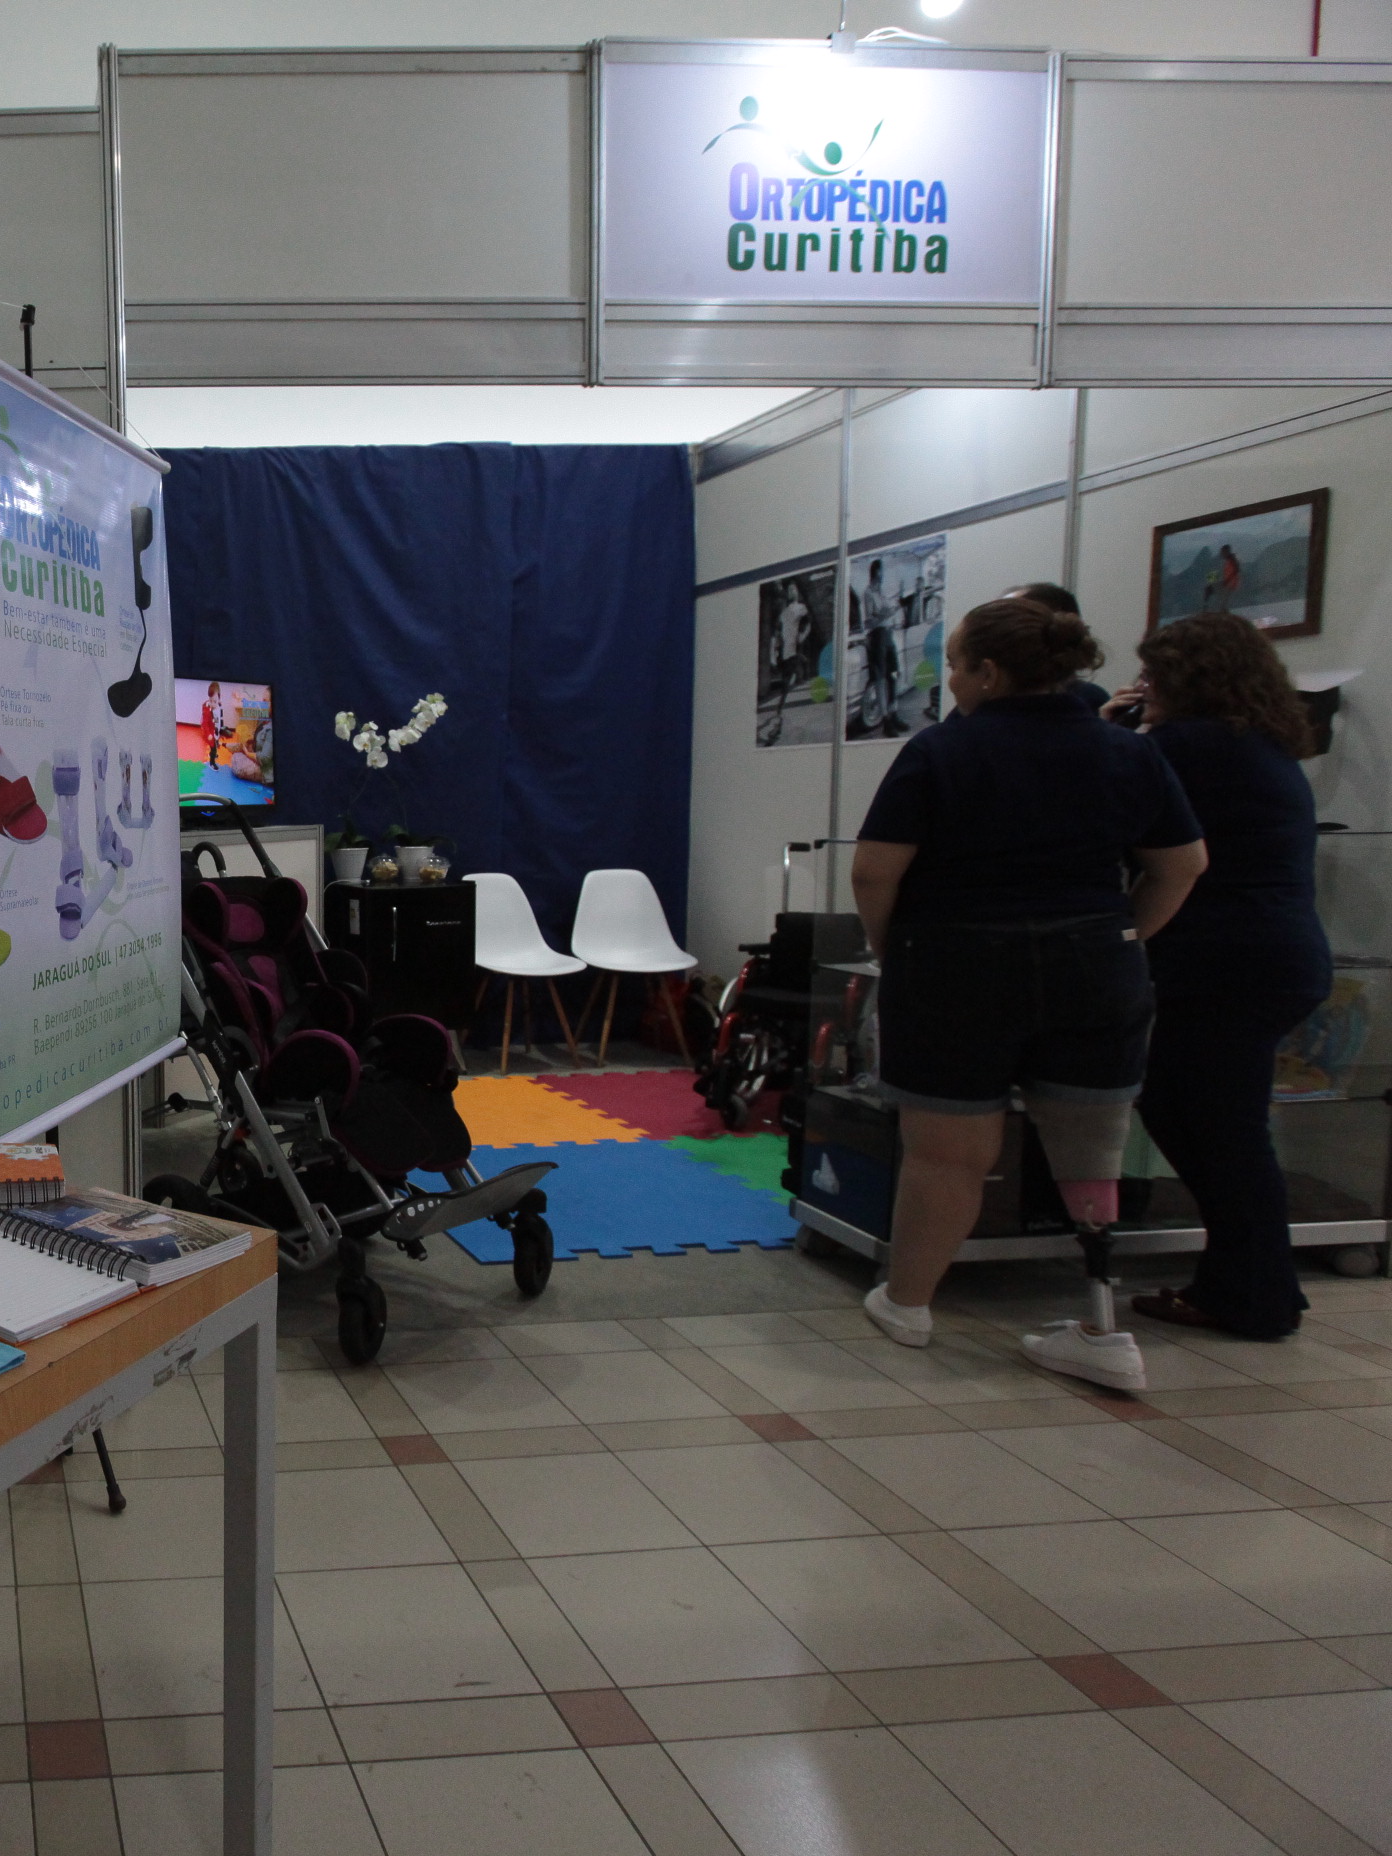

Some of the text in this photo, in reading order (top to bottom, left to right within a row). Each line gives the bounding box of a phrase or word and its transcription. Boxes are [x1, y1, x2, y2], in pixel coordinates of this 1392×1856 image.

[728, 162, 948, 224] ORTOPÉDICA
[726, 222, 949, 274] Curitiba
[1, 538, 105, 617] Curitiba
[3, 599, 49, 625] Bem-estar
[51, 612, 83, 634] também
[91, 625, 106, 640] uma
[4, 619, 108, 658] Necessidade Especial
[32, 956, 80, 991] JARAGUÁ
[82, 955, 95, 974] DO
[96, 949, 112, 969] SUL
[119, 943, 127, 959] 47
[45, 1002, 82, 1031] Bernardo
[34, 1027, 73, 1056] Baependi
